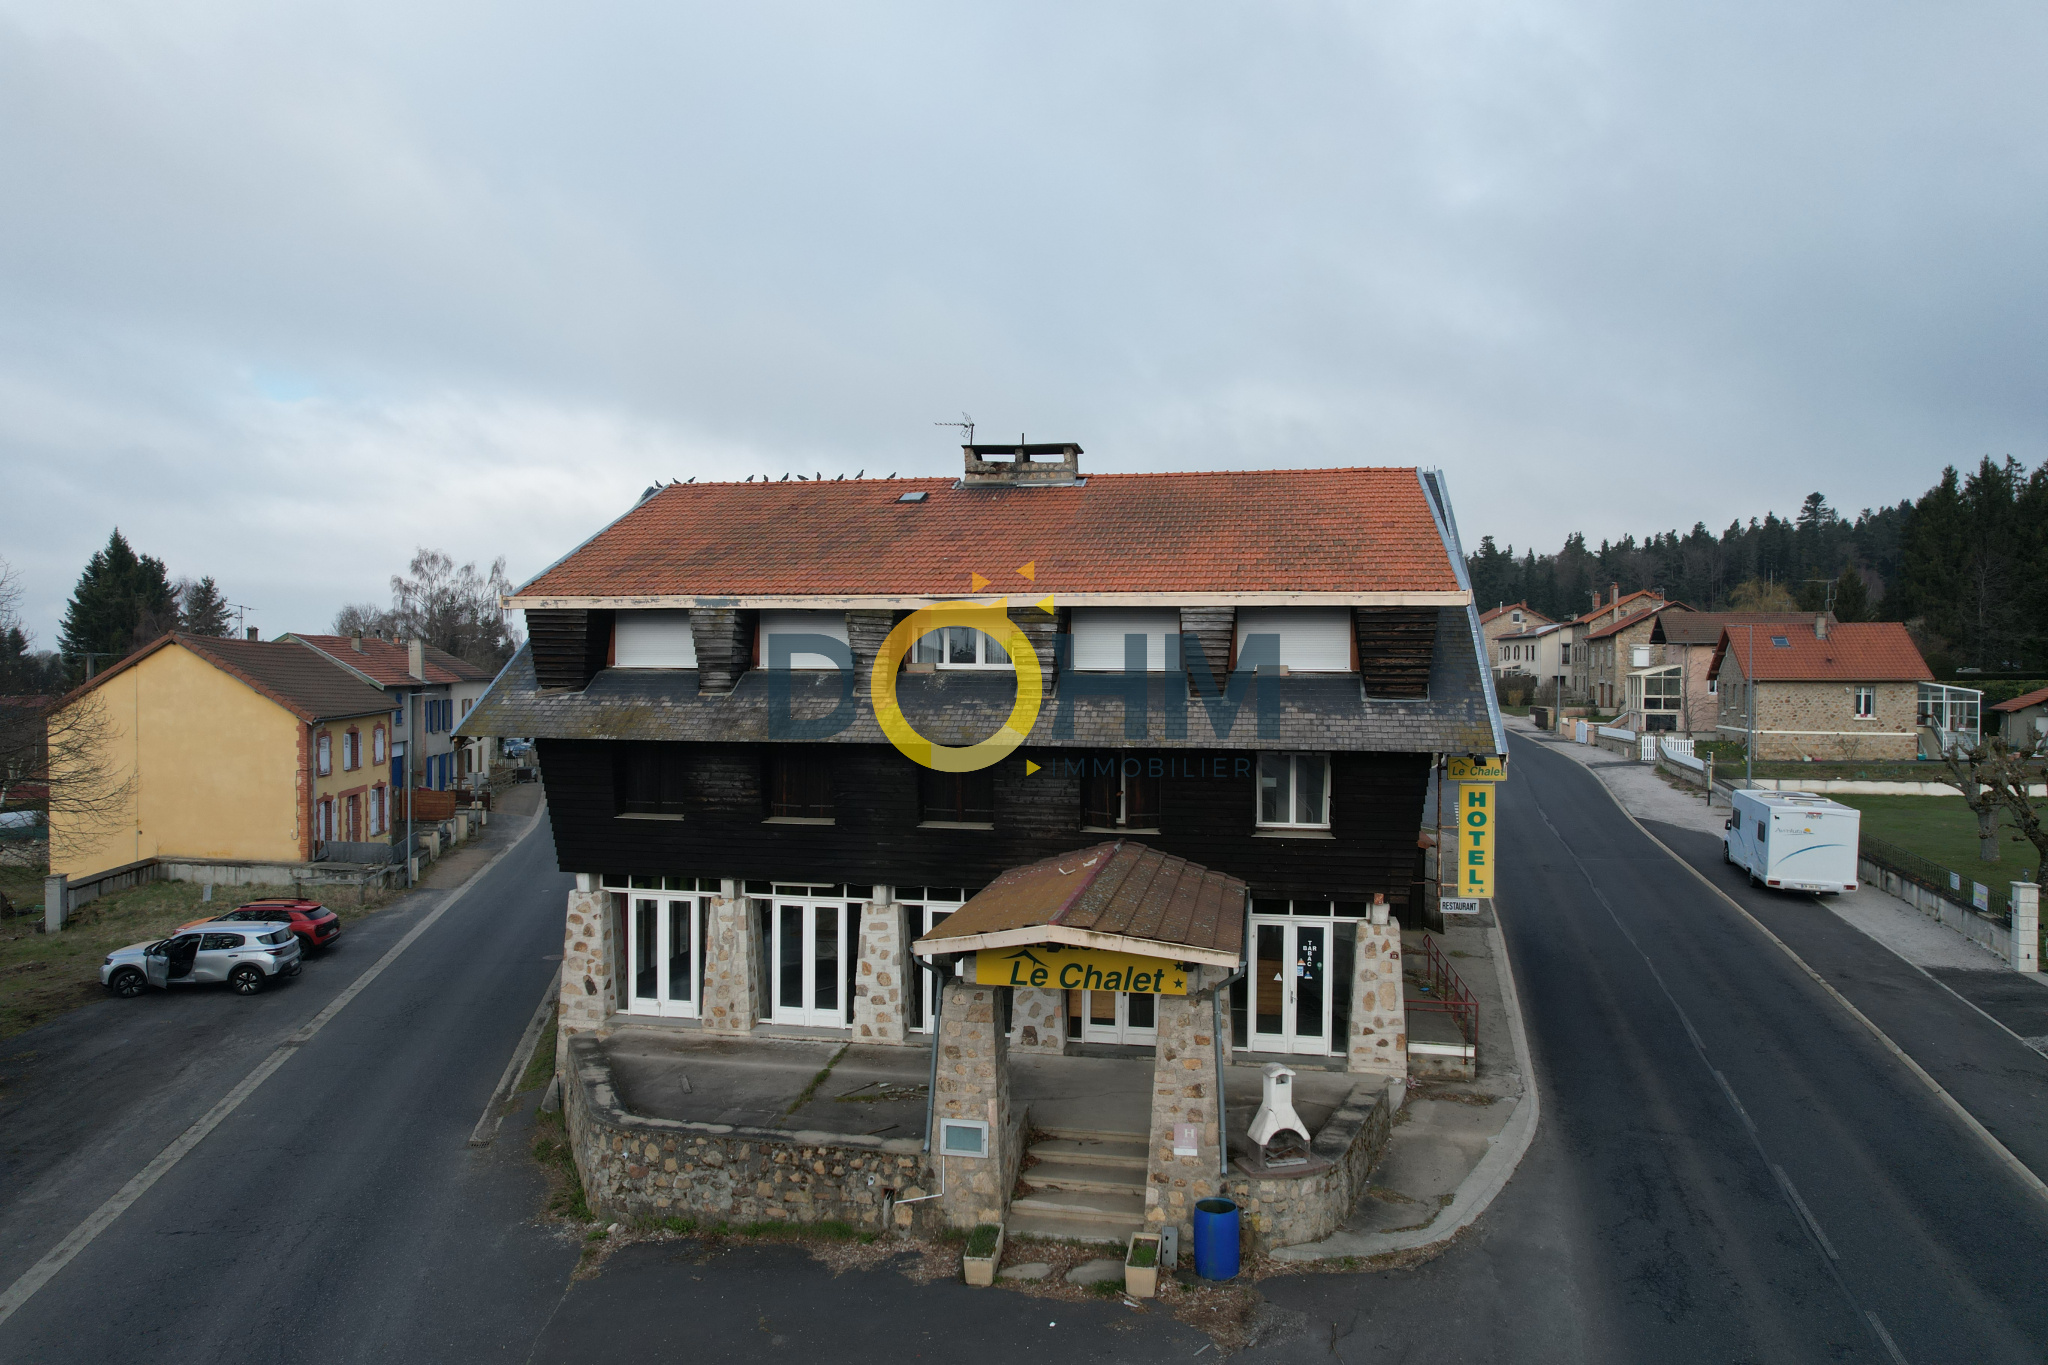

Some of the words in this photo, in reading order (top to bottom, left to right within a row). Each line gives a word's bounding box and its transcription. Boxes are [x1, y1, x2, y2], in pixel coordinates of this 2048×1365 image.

[1452, 766, 1465, 776] Le
[1470, 766, 1504, 776] Chalet
[1467, 792, 1487, 884] HOTEL
[1442, 901, 1477, 911] RESTAURANT
[1009, 960, 1049, 987] Le
[1059, 963, 1165, 993] Chalet
[1184, 1128, 1195, 1139] H
